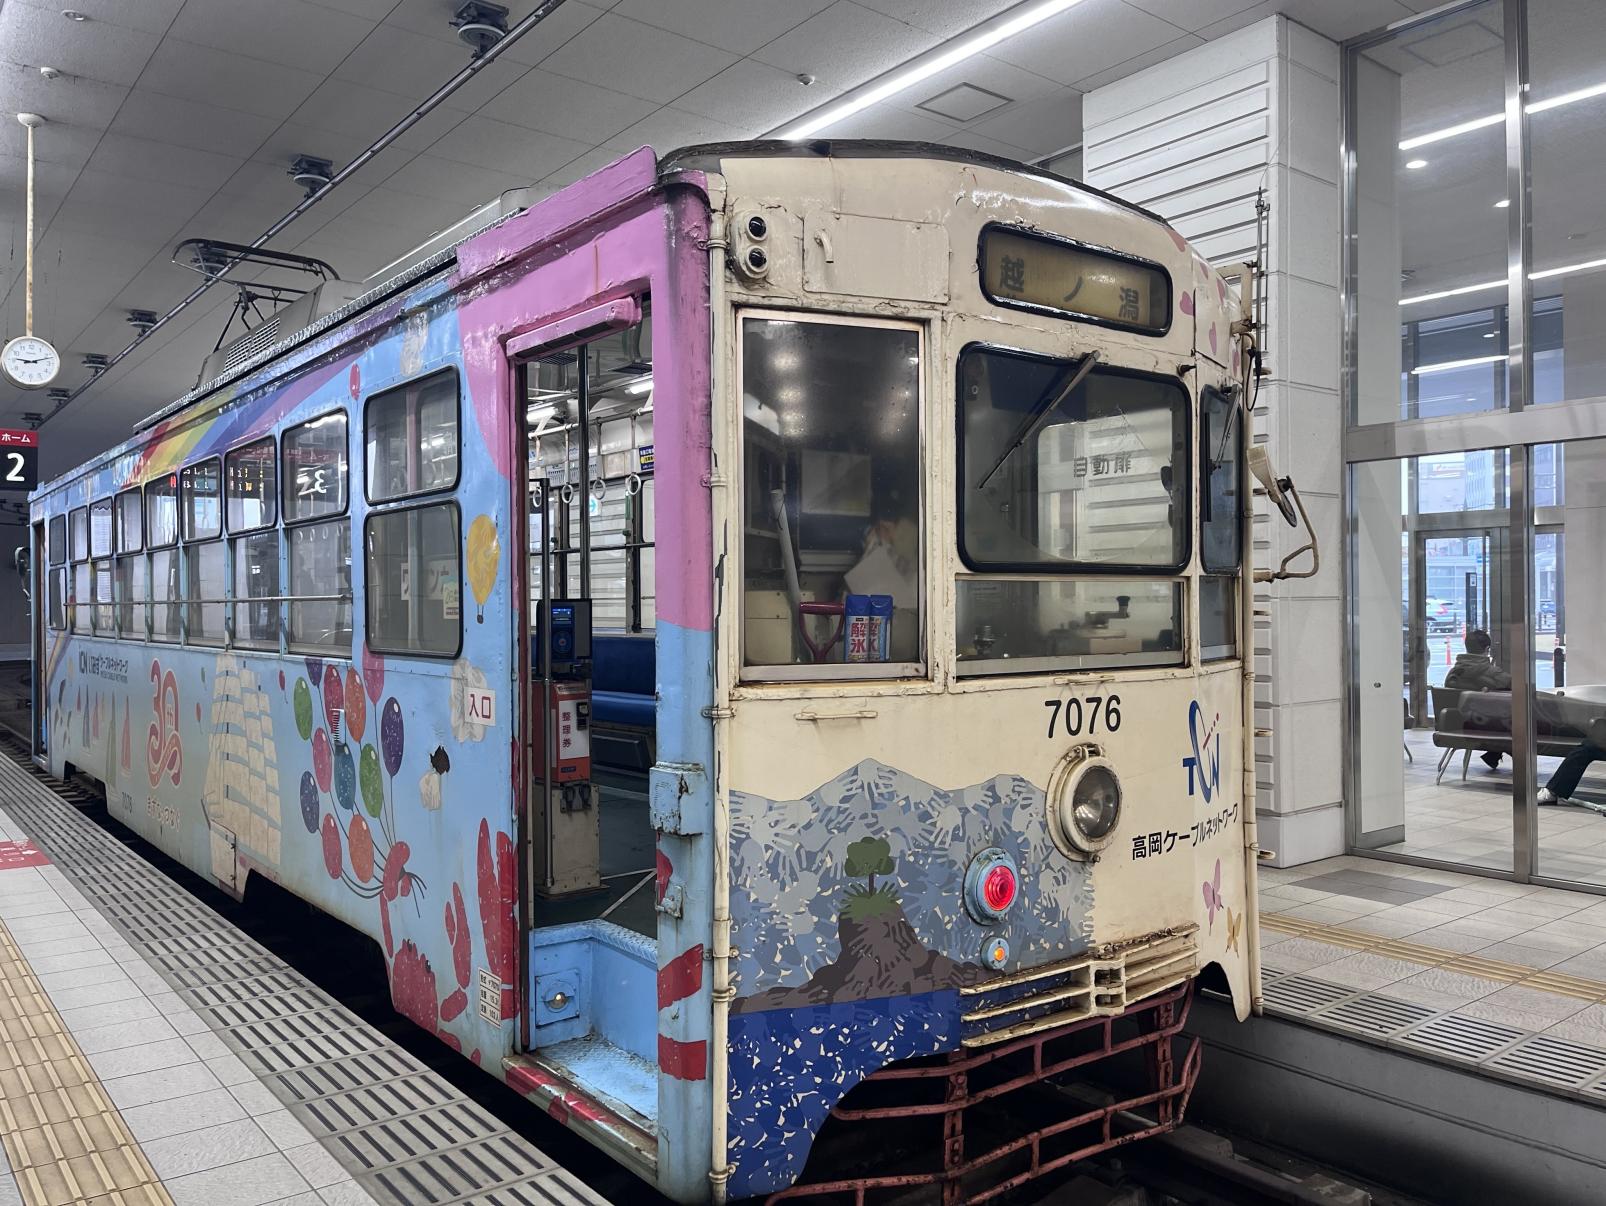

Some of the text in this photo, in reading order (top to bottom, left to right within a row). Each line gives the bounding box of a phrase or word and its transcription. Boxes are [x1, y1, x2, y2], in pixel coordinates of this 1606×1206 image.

[1, 432, 31, 443] ホーム
[6, 452, 25, 482] 2
[1073, 452, 1132, 478] 自動扉
[469, 693, 491, 719] 入口
[1044, 694, 1121, 739] 7076
[562, 711, 572, 748] 整理券
[1131, 802, 1238, 861] 高岡ケーブルネットワーク
